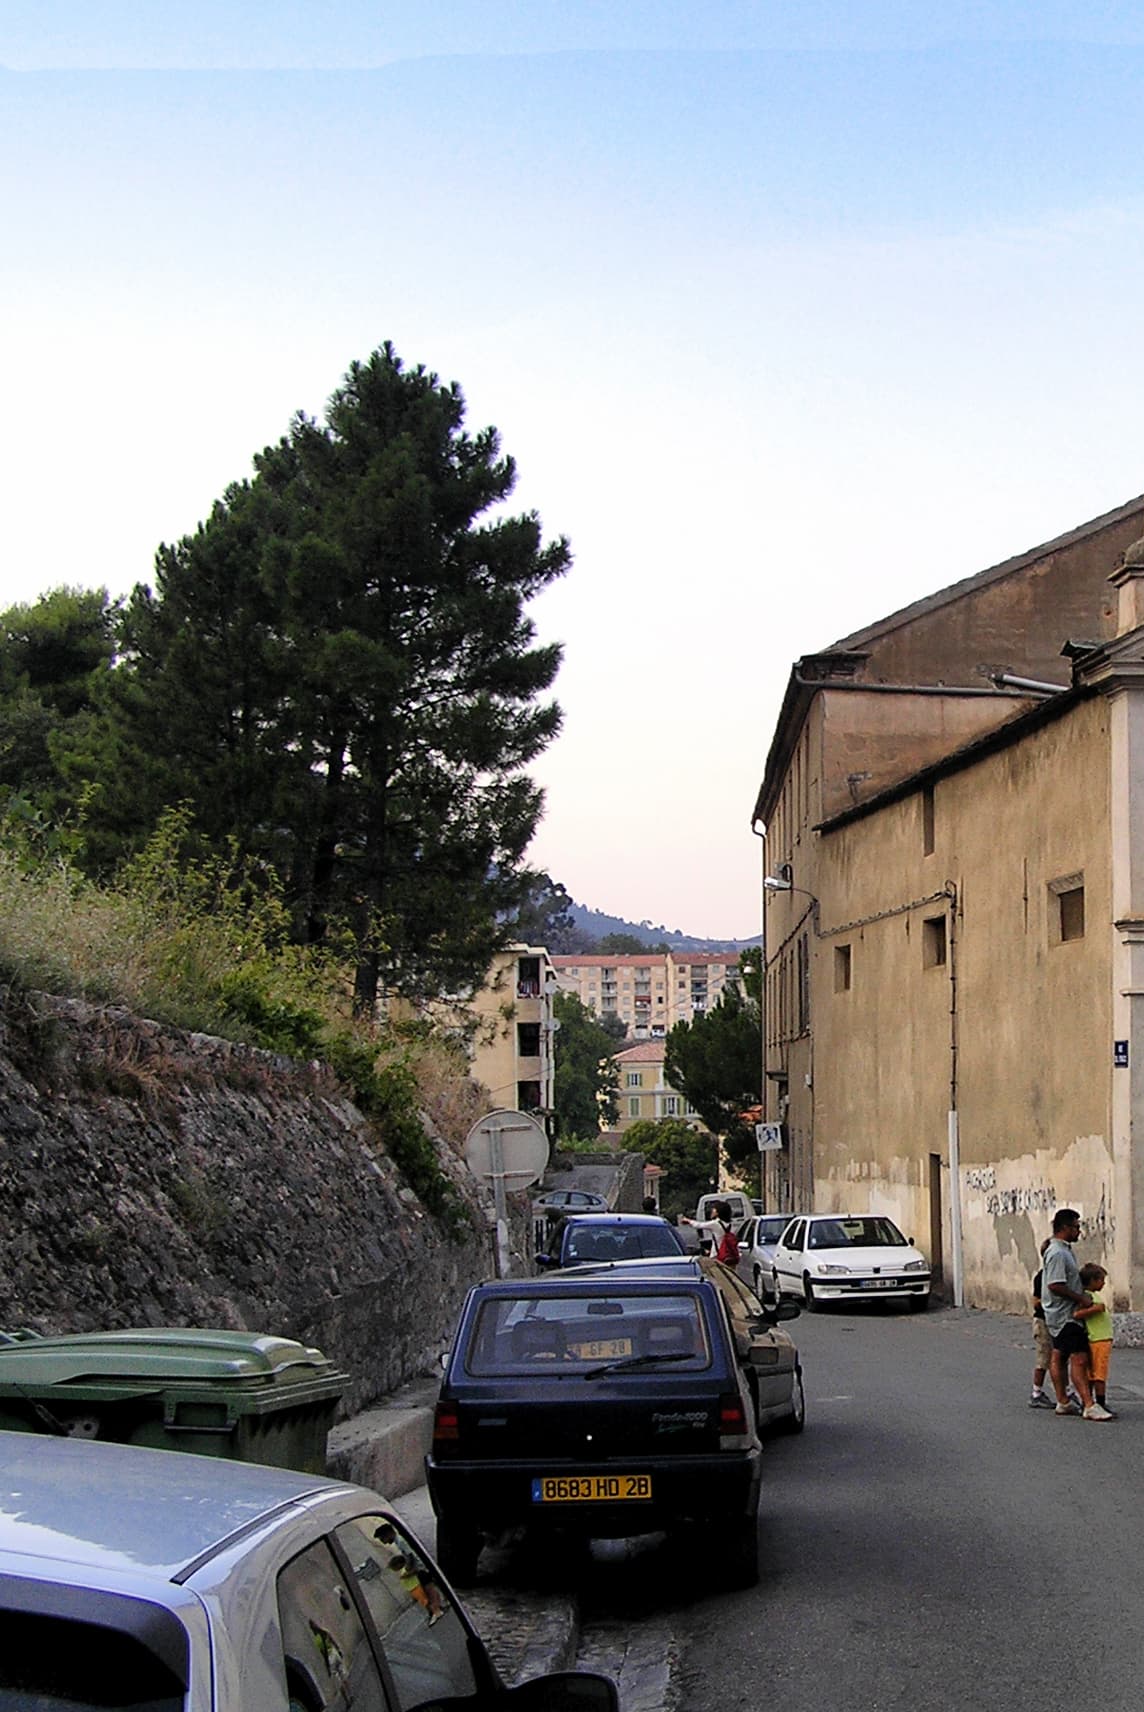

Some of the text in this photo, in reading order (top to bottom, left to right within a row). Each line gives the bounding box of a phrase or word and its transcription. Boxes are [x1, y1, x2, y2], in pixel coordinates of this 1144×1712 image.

[545, 1477, 649, 1498] 8683 HD 2B
